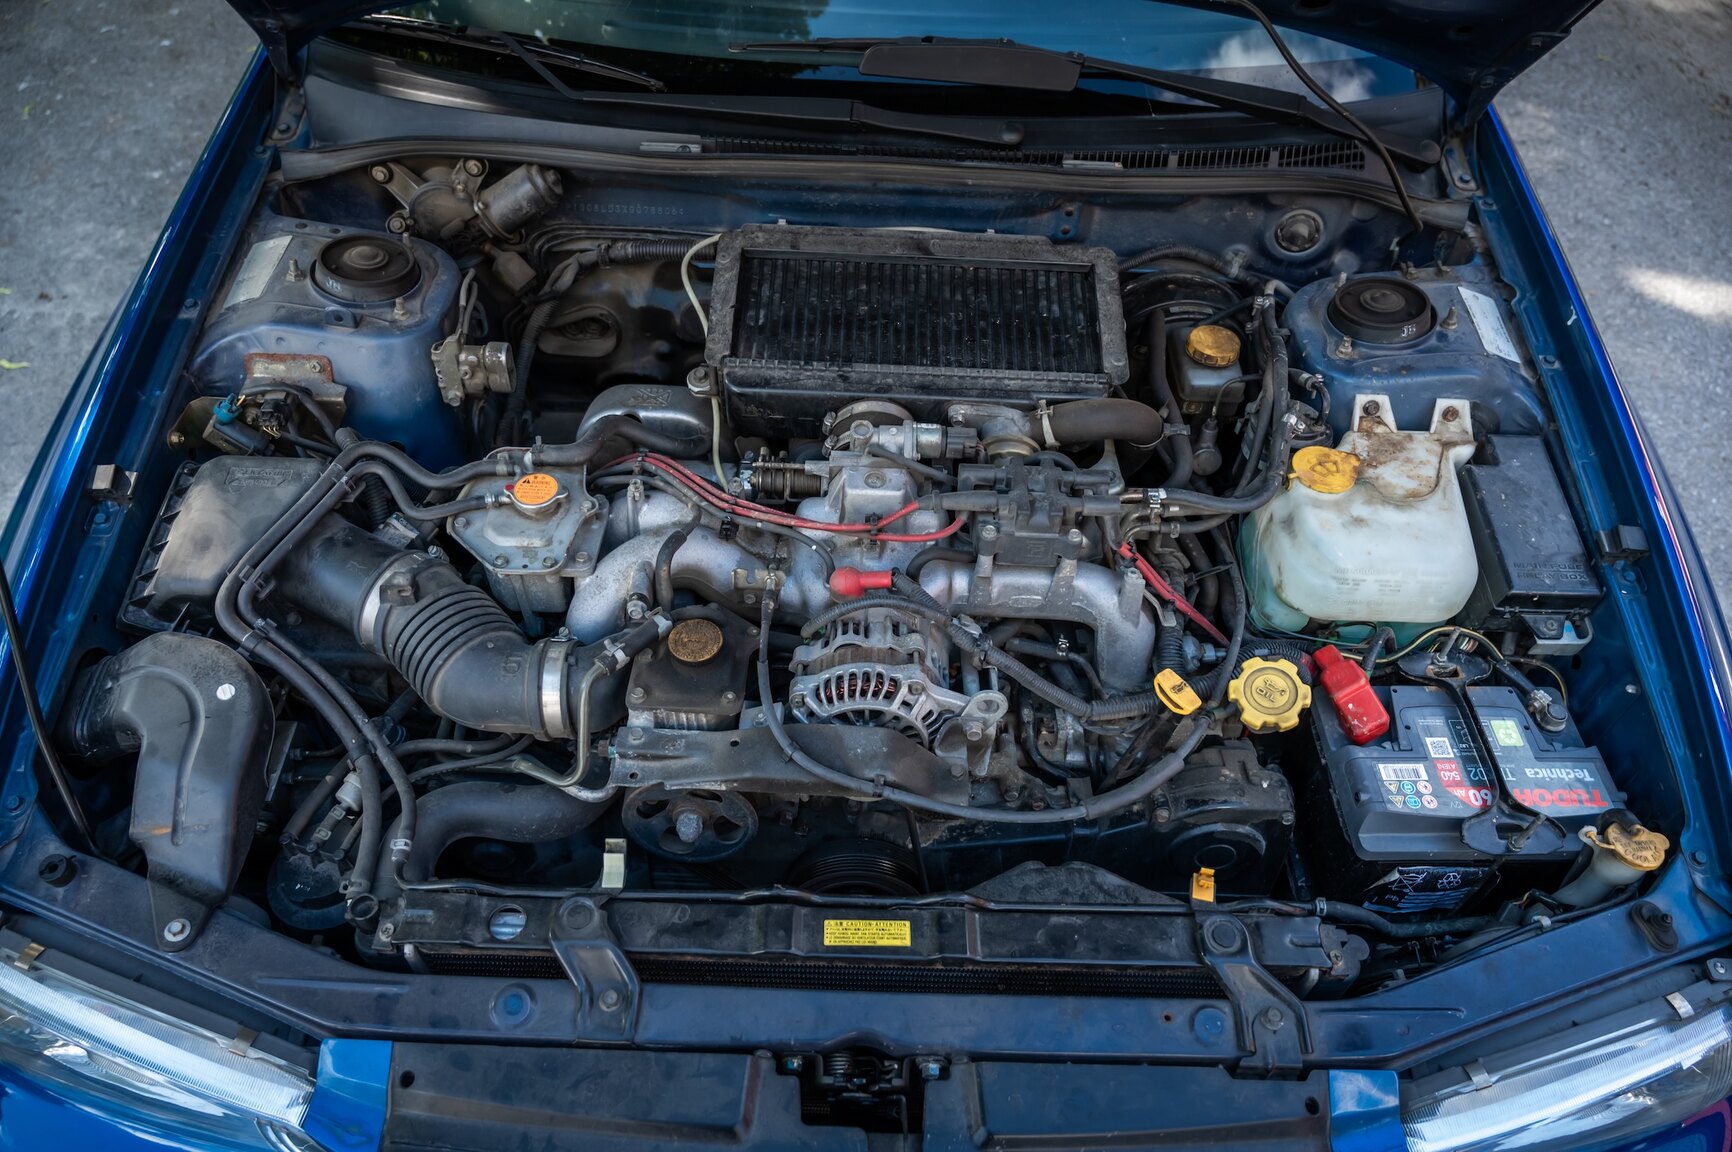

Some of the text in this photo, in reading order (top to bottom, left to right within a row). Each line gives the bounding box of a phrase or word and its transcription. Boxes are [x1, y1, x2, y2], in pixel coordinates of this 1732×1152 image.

[1560, 573, 1588, 581] BOX
[1256, 687, 1275, 702] OIL
[1440, 771, 1461, 781] 540
[1524, 768, 1595, 782] Technica
[1512, 788, 1608, 808] TUDOR
[1450, 800, 1463, 809] 12V
